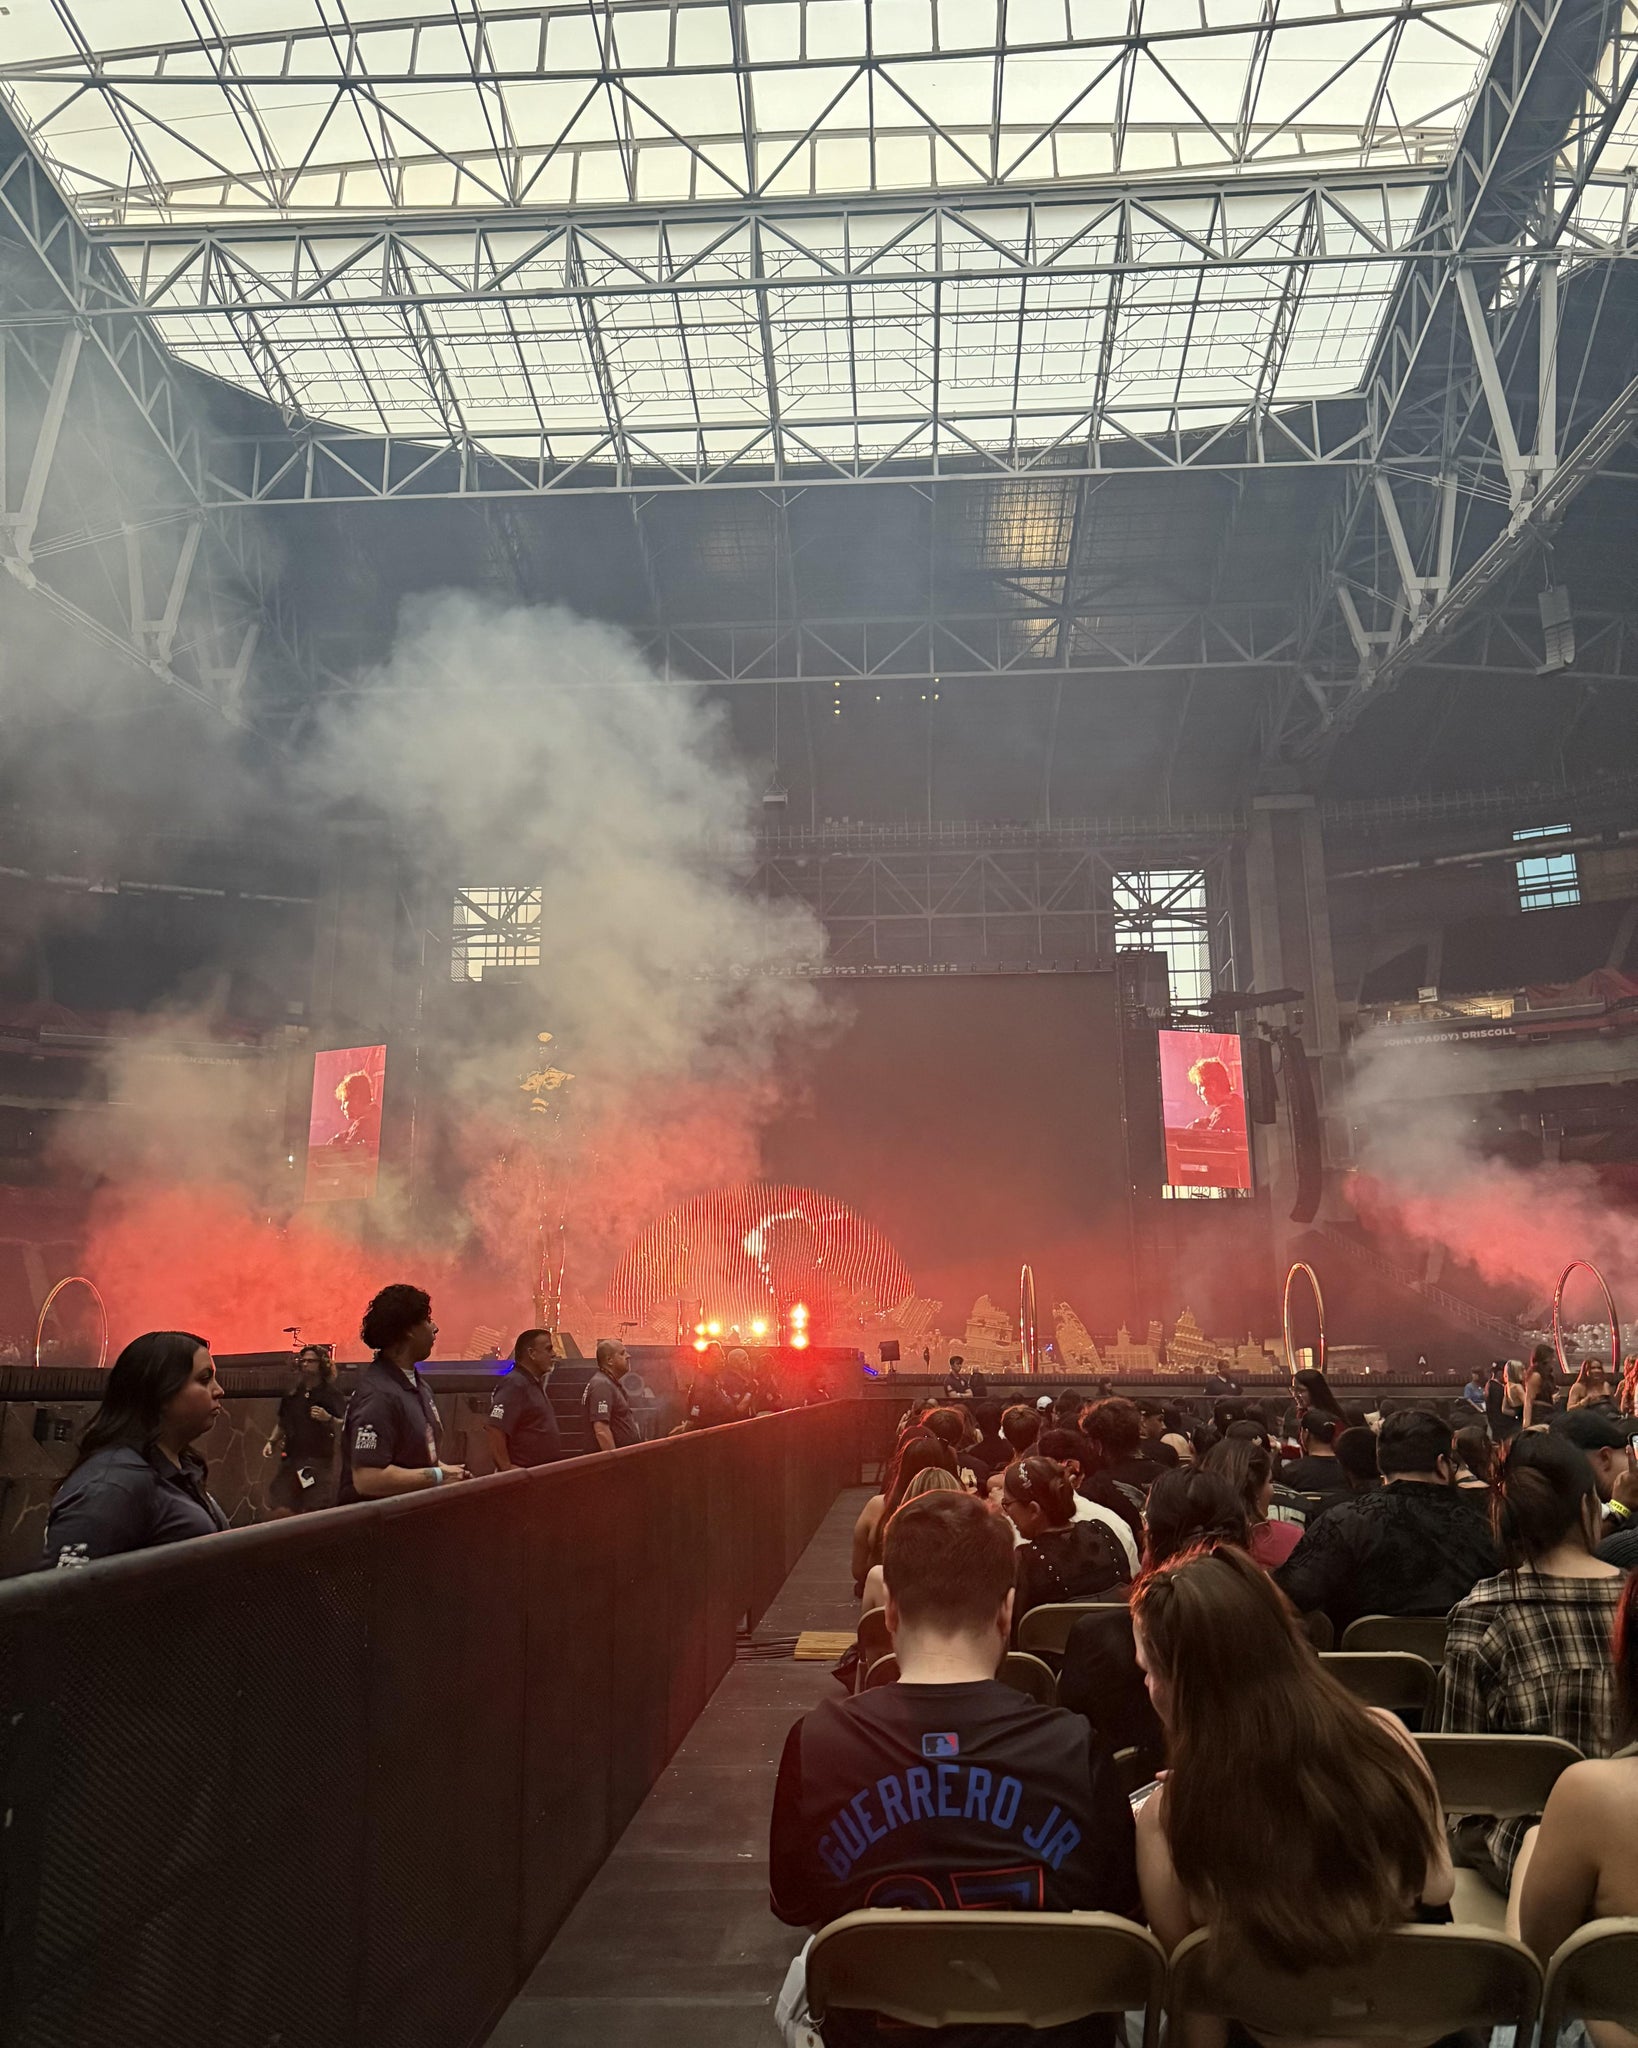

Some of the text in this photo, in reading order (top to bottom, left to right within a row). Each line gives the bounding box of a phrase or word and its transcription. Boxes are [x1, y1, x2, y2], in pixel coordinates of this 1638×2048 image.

[1383, 1027, 1517, 1047] JOHN (PADDY) DRISCOLL
[817, 1764, 1082, 1882] GUERRERO JR
